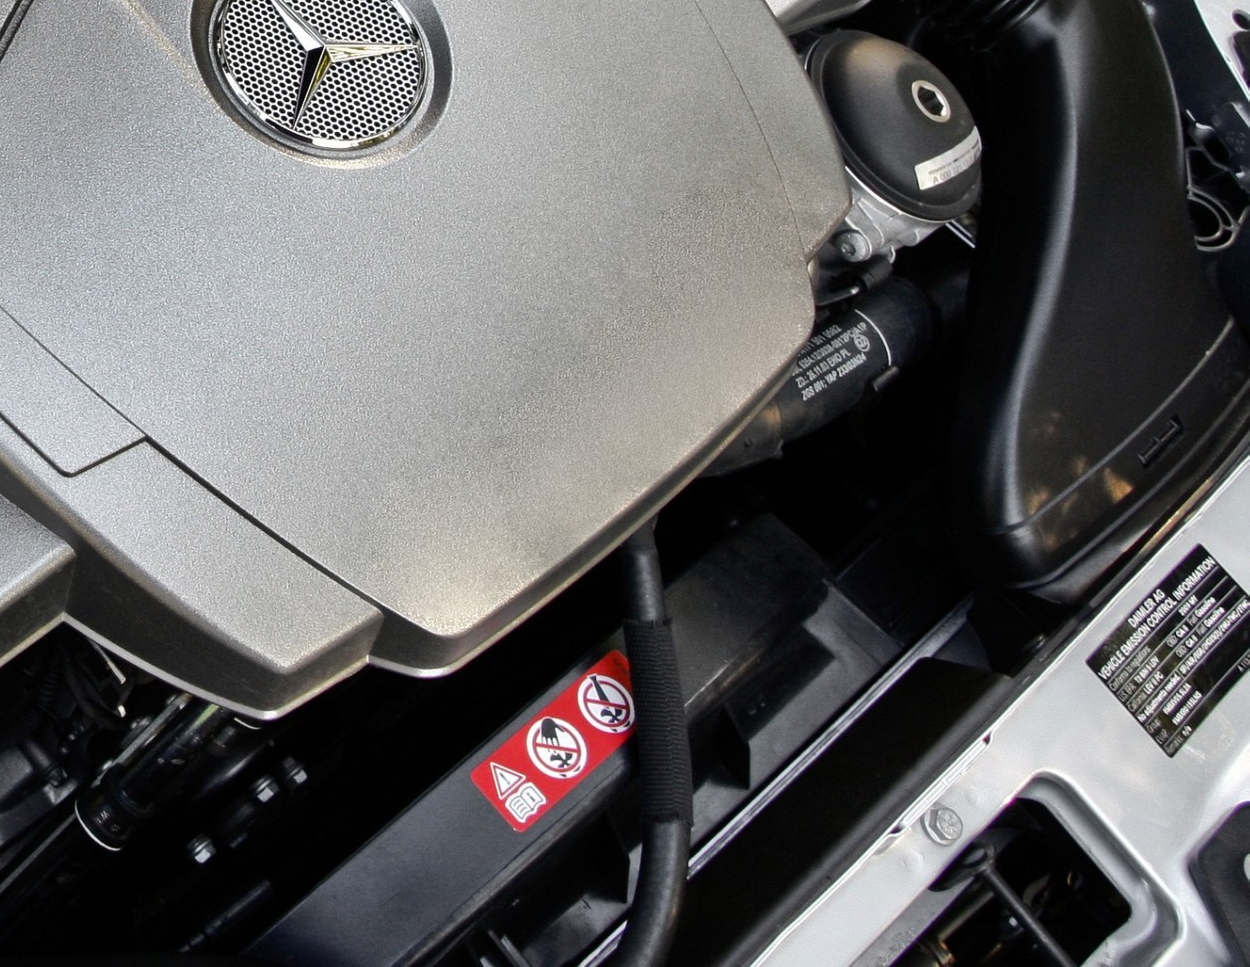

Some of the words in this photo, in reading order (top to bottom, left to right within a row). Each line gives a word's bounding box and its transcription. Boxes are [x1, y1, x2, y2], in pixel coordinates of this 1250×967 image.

[802, 386, 814, 400] ZGS
[1128, 599, 1155, 627] DAIMLER
[1153, 589, 1165, 602] AG
[1195, 597, 1215, 617] Gasoline
[1204, 607, 1224, 627] Gasoline
[1099, 651, 1124, 679] VEHICLE
[1121, 624, 1150, 655] EMISSION
[1147, 598, 1176, 627] CONTROL
[1173, 557, 1214, 600] INFORMATION
[1144, 682, 1154, 694] LEV
[1137, 713, 1146, 722] No
[1144, 690, 1167, 716] adjustments
